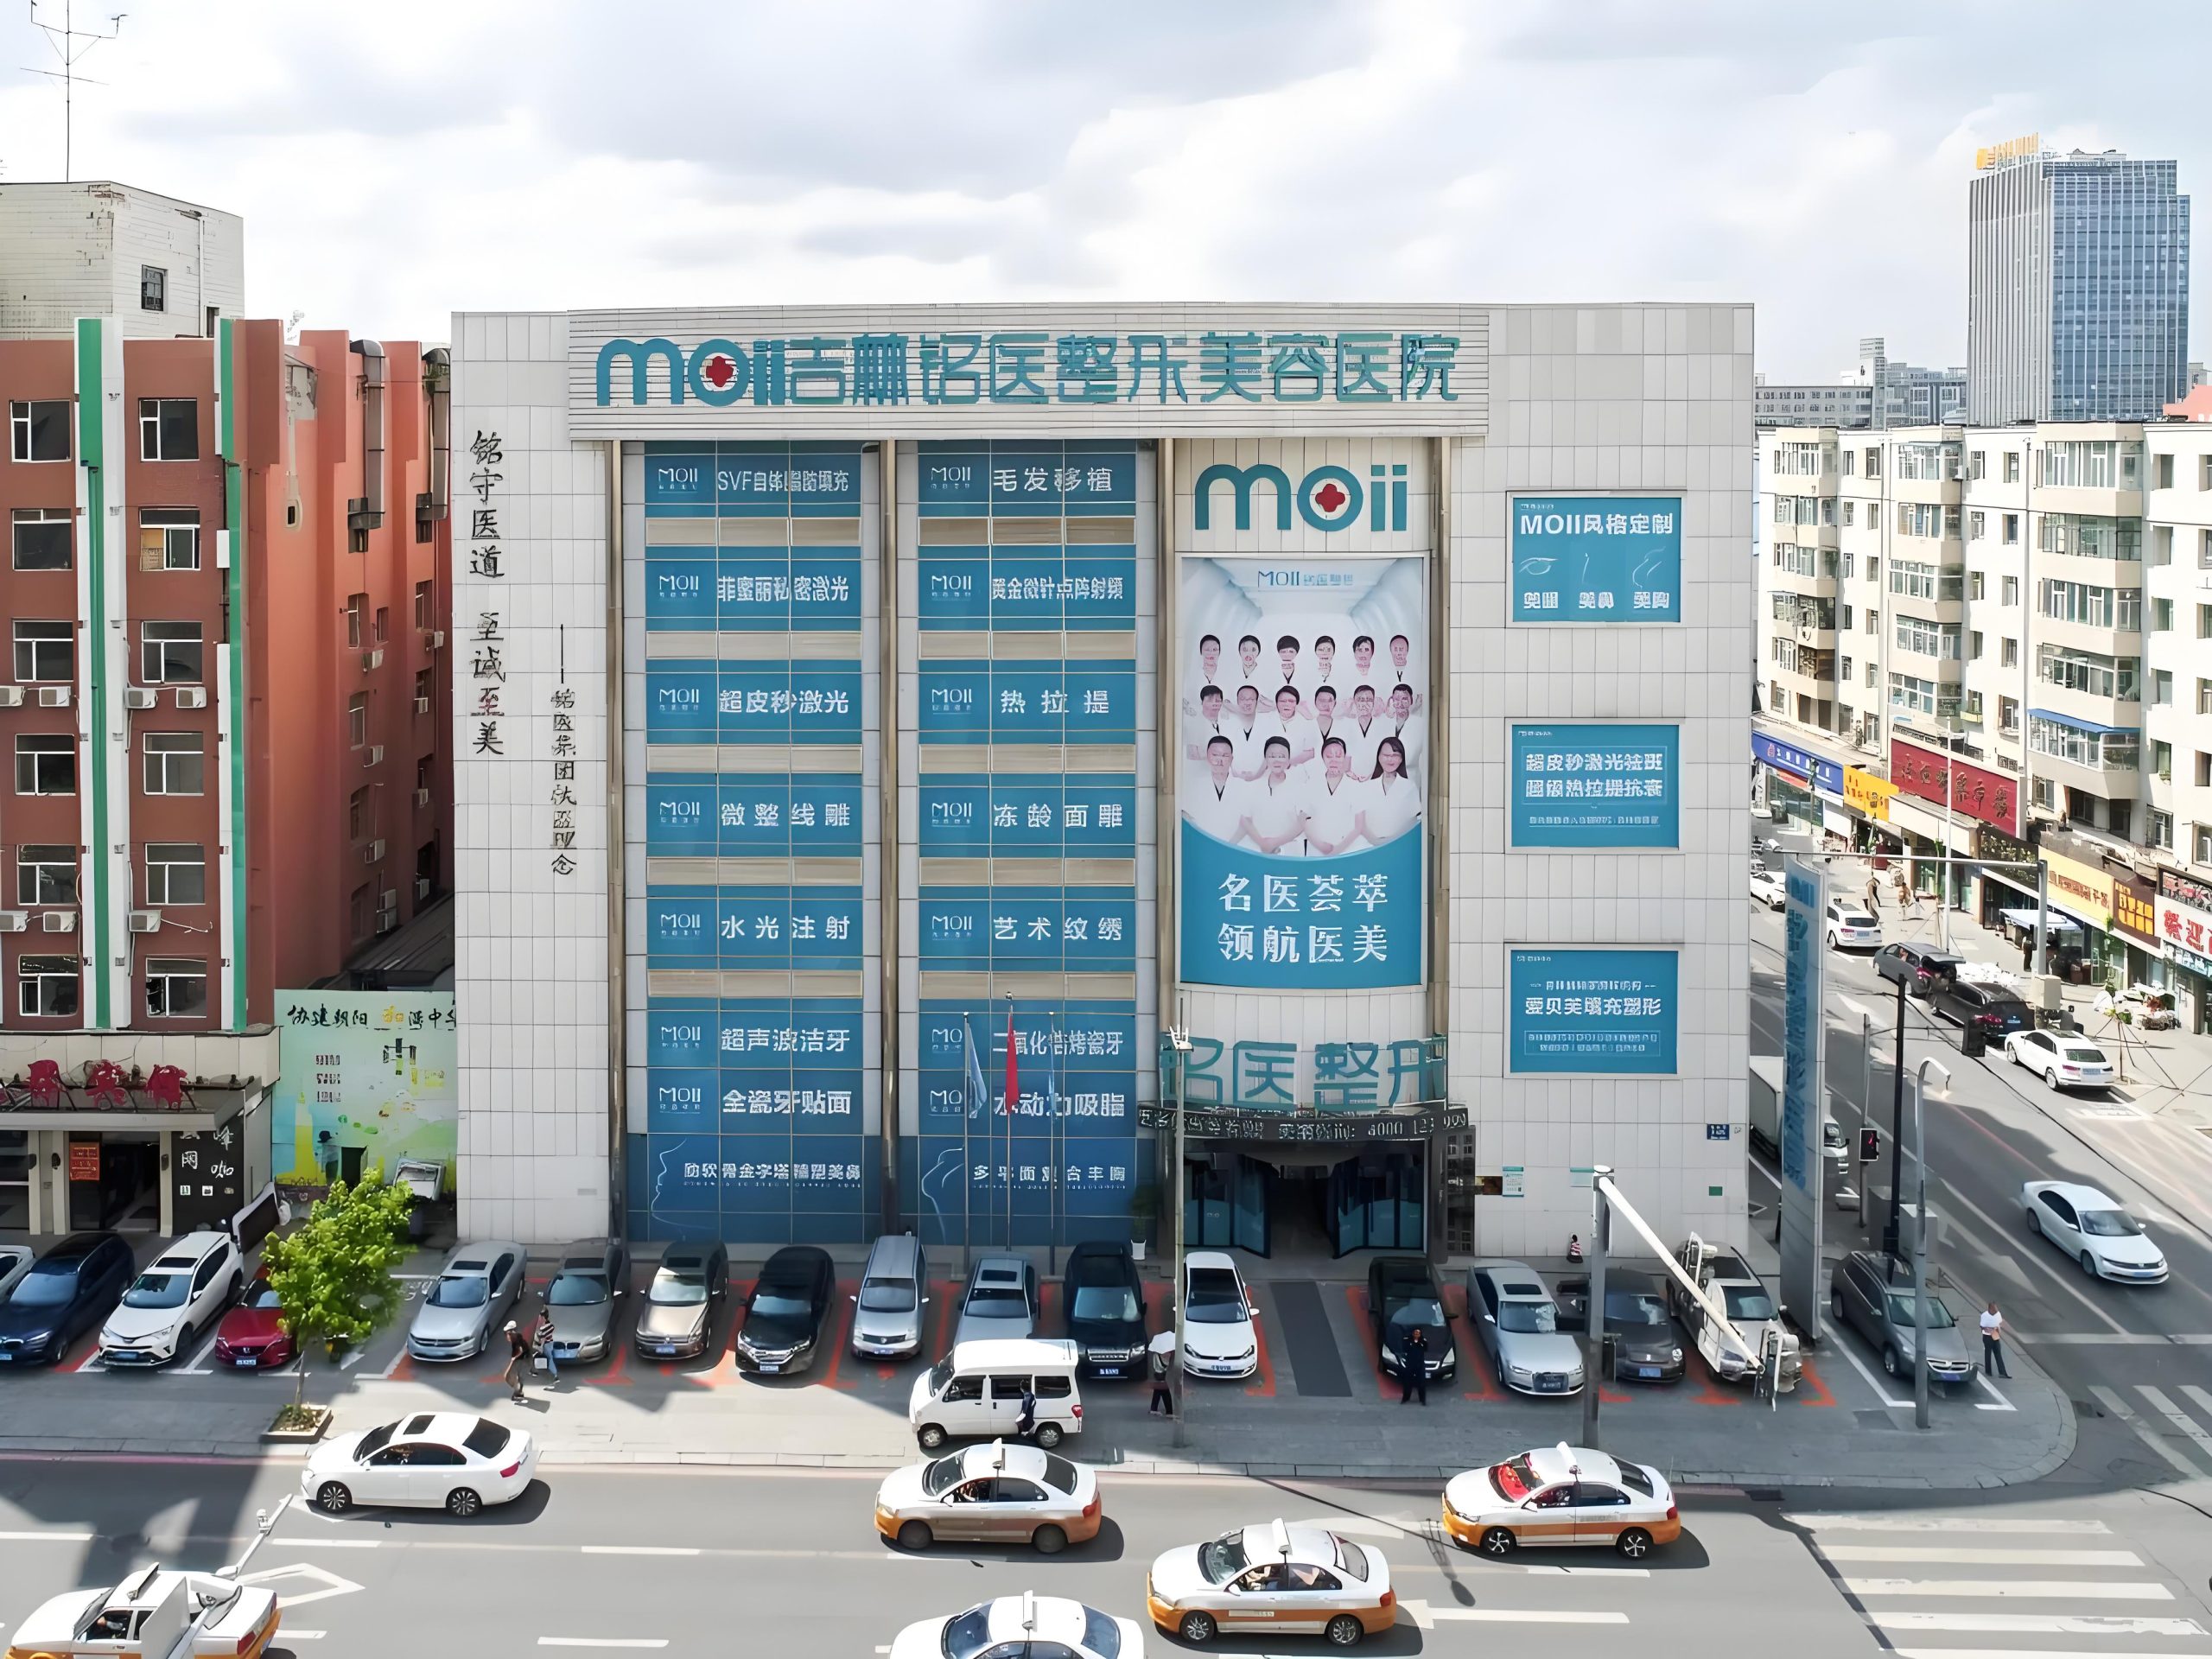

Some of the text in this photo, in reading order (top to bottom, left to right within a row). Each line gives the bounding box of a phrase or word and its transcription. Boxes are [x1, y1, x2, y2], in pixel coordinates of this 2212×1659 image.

[993, 467, 1113, 493] 毛发移植
[719, 690, 849, 715] 超皮秒激光
[1001, 690, 1109, 714] 热拉提
[721, 803, 850, 827] 微整线雕
[993, 804, 1122, 828] 冻龄面雕
[1218, 874, 1388, 912] 名医荟萃
[721, 916, 850, 940] 水光注射
[993, 918, 1122, 941] 艺术纹绣
[1218, 924, 1387, 963] 领航医美
[721, 1028, 850, 1052] 超声波洁牙
[722, 1090, 852, 1114] 全瓷牙贴面
